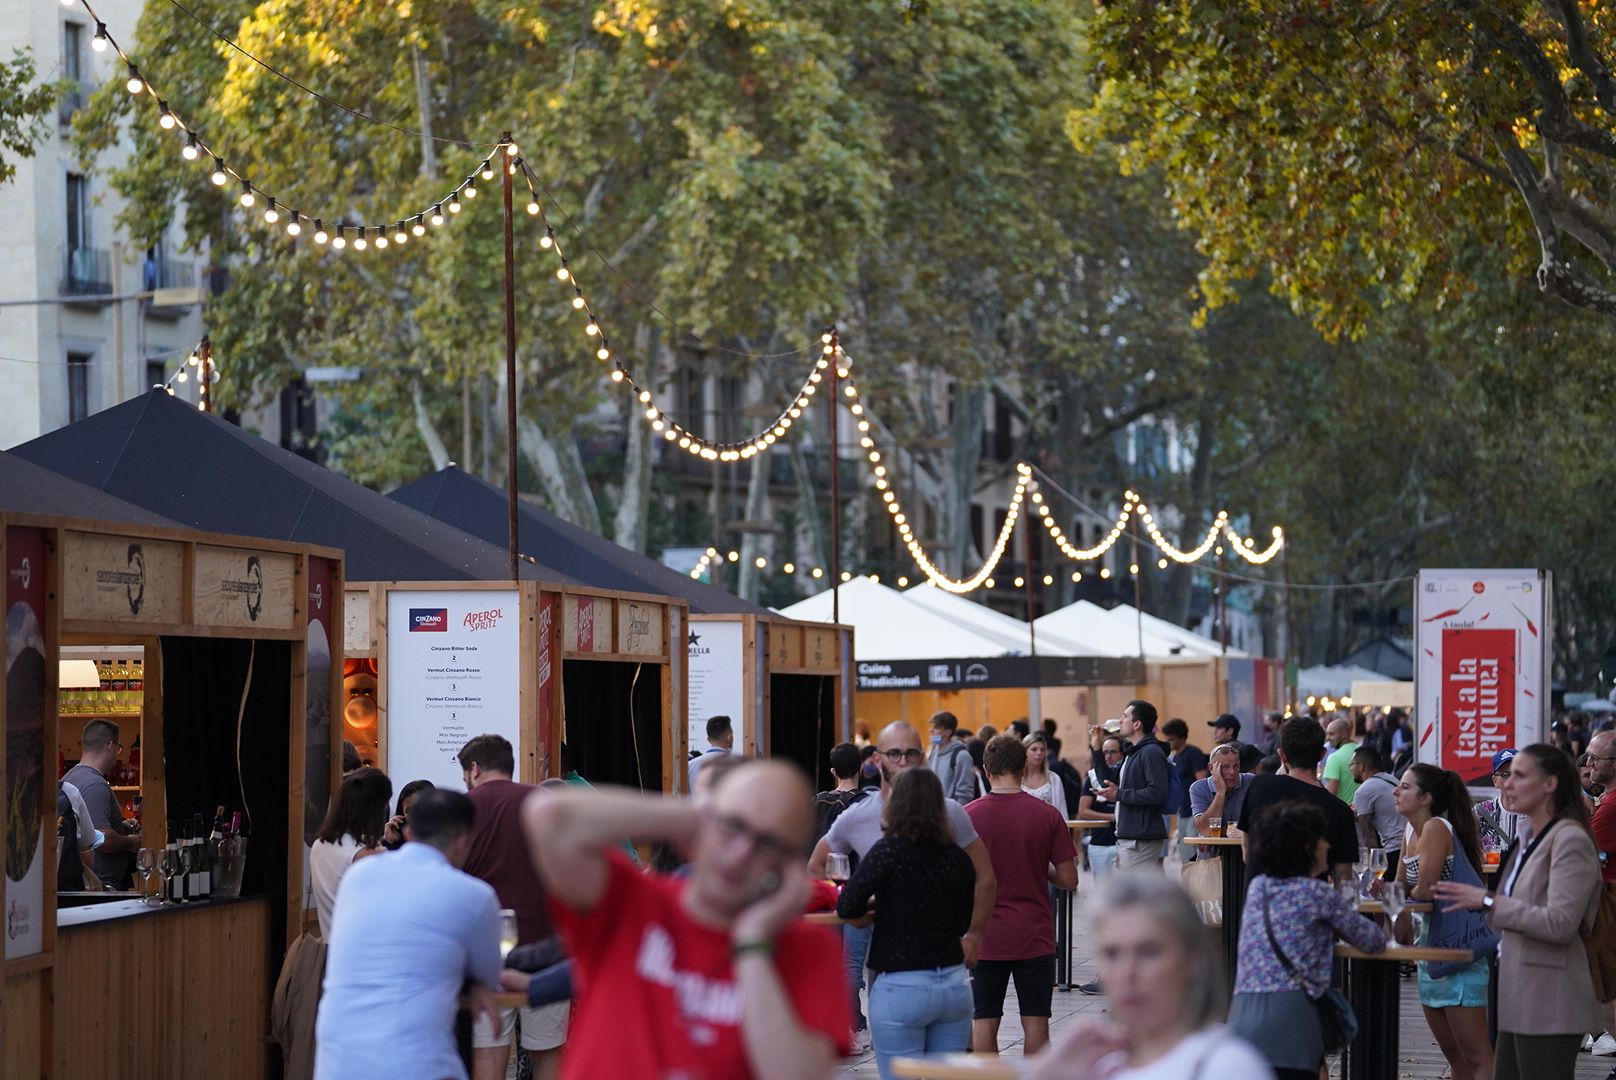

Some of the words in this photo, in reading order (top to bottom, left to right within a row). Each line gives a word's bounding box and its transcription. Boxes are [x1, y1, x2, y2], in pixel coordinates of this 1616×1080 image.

[415, 615, 441, 623] CINZANO
[463, 608, 503, 626] APEROL
[470, 619, 496, 632] SPRITZ
[858, 663, 892, 675] Cuina
[1449, 658, 1478, 682] la
[860, 675, 920, 688] Tradicional
[1458, 687, 1478, 704] a
[1480, 658, 1508, 758] rambla
[1453, 707, 1478, 758] tast
